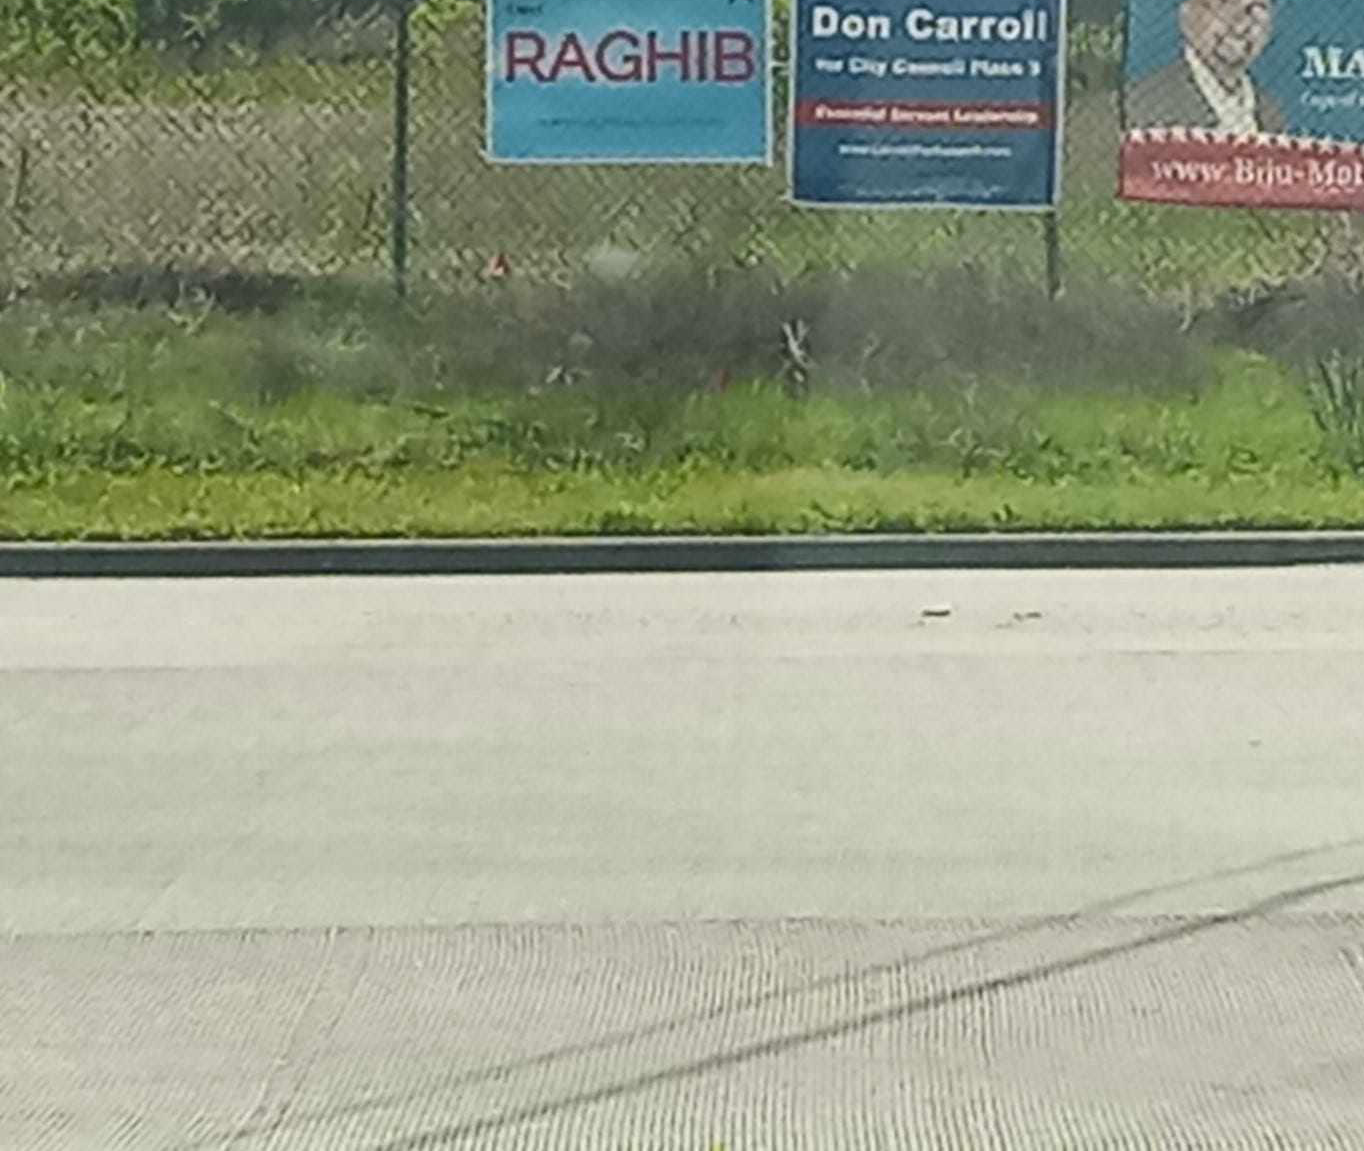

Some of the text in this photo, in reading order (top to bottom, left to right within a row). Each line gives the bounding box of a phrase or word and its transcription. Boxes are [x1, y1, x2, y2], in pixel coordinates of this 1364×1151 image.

[811, 5, 1048, 42] Don Carroll
[504, 29, 756, 85] RAGHIB
[849, 56, 887, 78] City
[892, 57, 966, 76] Council
[970, 59, 1024, 77] Place
